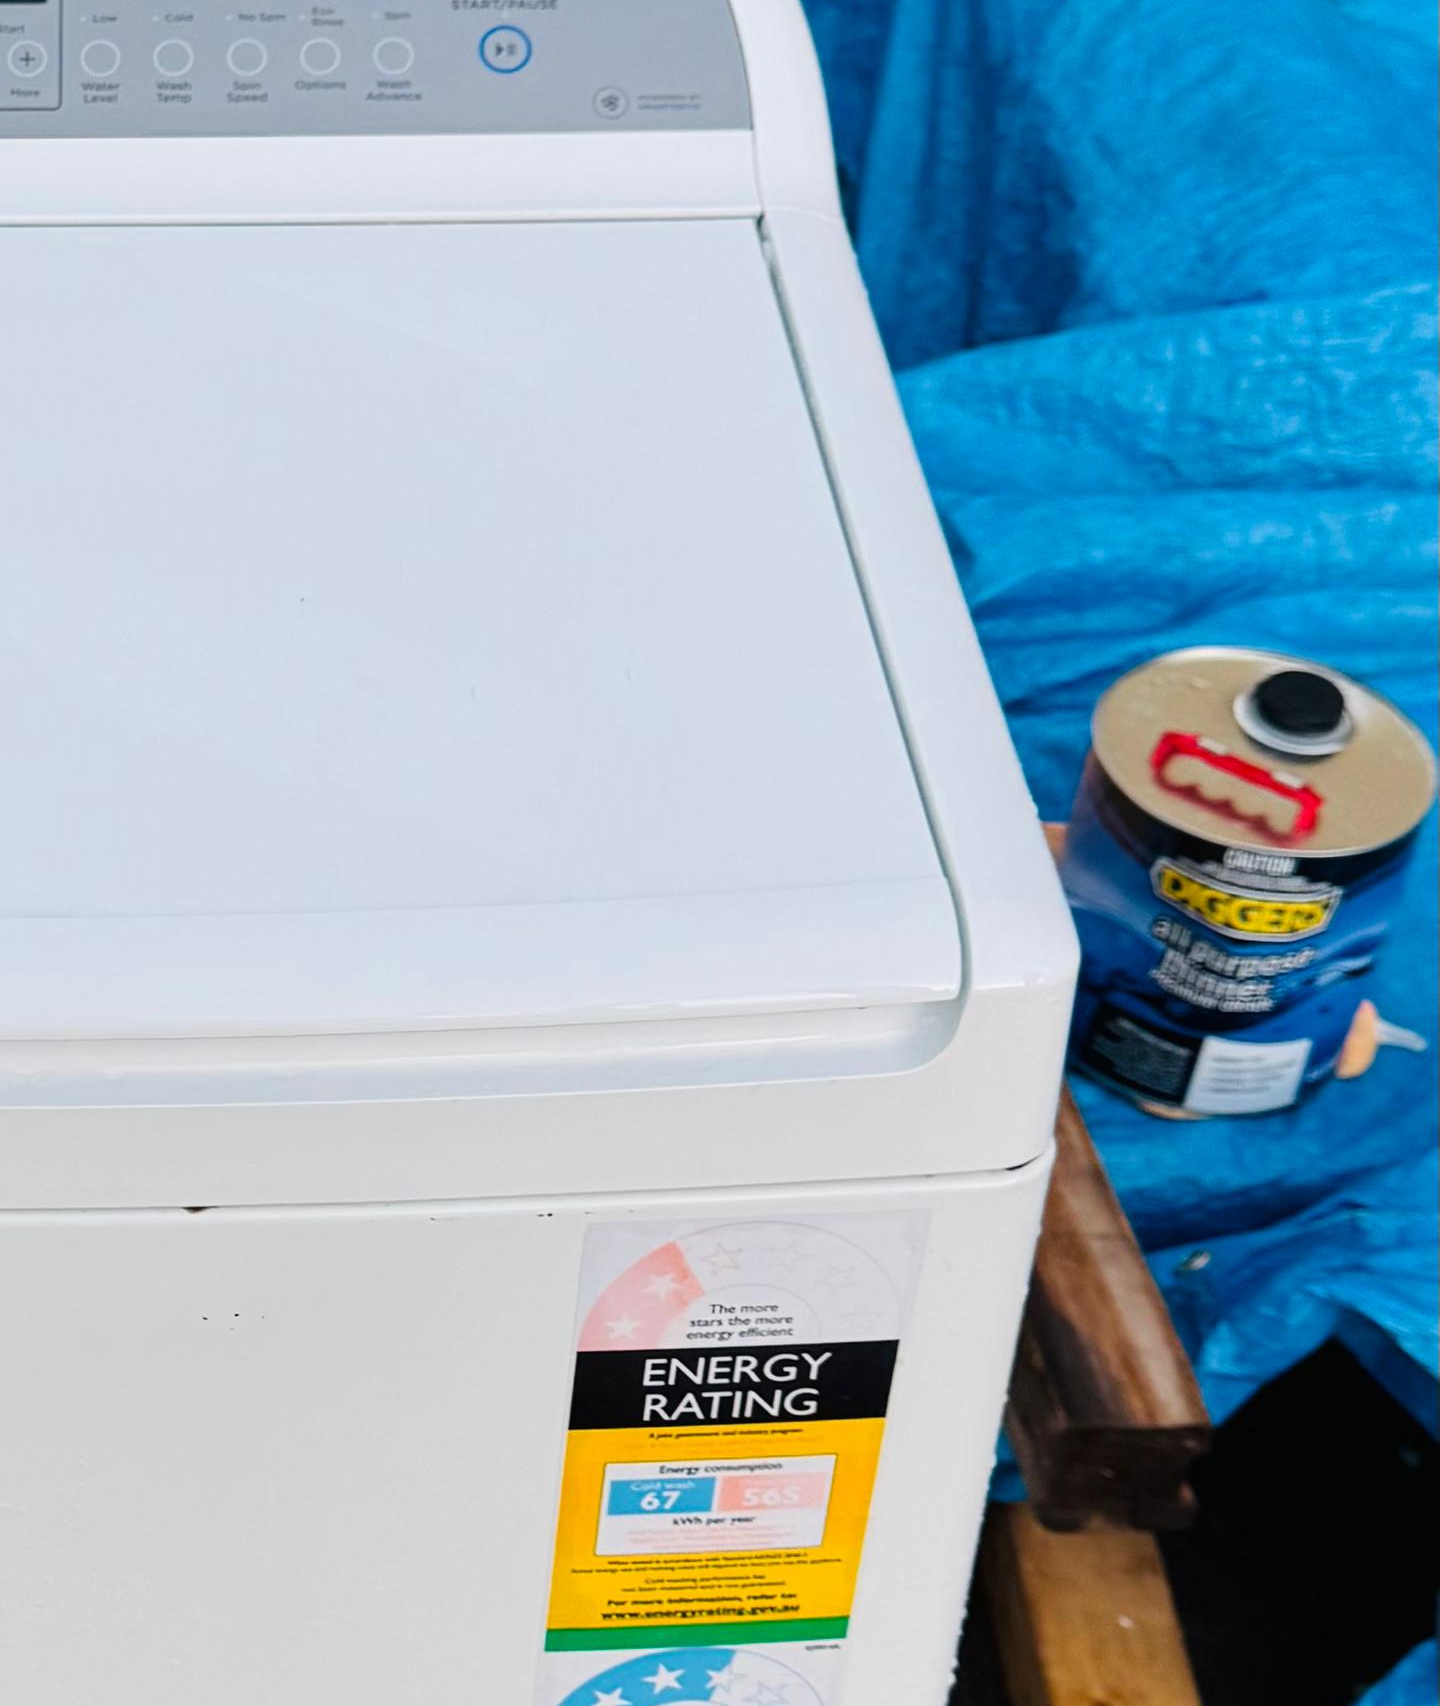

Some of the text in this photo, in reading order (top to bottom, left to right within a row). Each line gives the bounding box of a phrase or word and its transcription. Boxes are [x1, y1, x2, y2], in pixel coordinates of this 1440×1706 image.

[80, 81, 121, 92] Water
[294, 79, 348, 92] Options
[83, 93, 119, 104] Level
[226, 92, 269, 103] Speed
[365, 91, 423, 102] Advance
[710, 1304, 779, 1315] The more
[689, 1315, 793, 1328] stars the more
[686, 1326, 794, 1341] energy efficient
[642, 1351, 832, 1387] ENERGY
[642, 1387, 820, 1421] RATING
[659, 1461, 783, 1476] Energy consumption
[639, 1490, 681, 1511] 67
[730, 1515, 757, 1526] year
[601, 1603, 800, 1621] www.energyrating.gov.au
